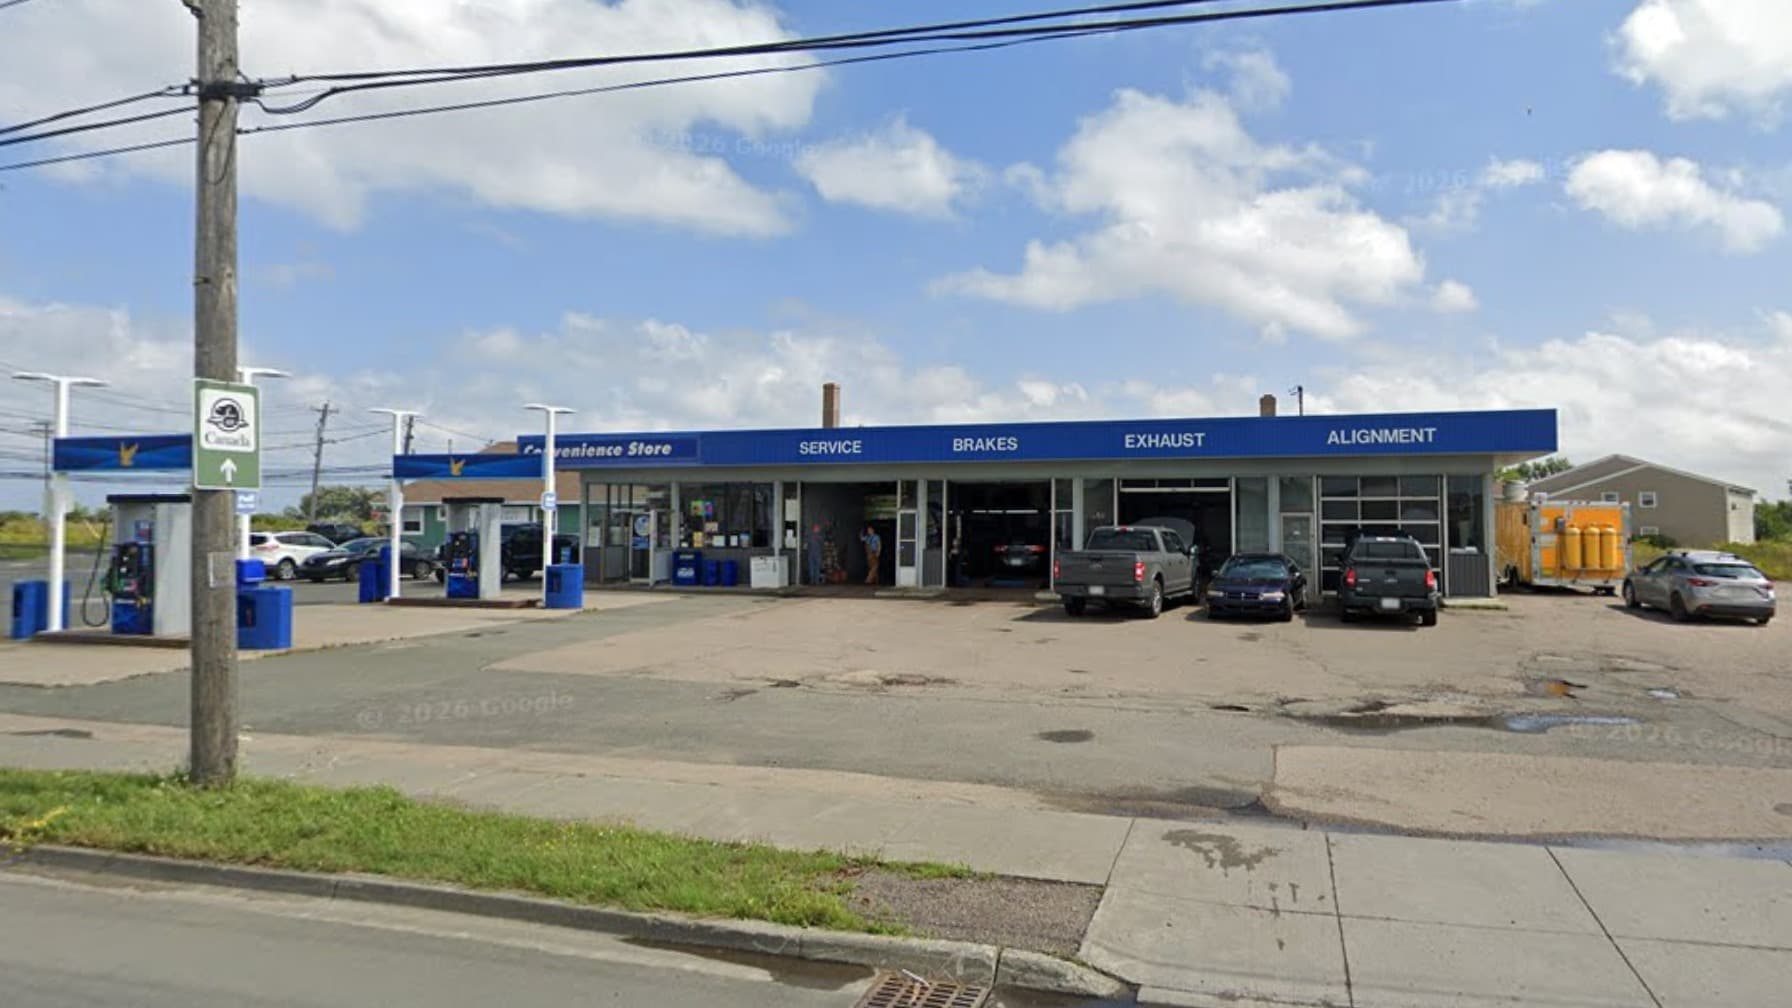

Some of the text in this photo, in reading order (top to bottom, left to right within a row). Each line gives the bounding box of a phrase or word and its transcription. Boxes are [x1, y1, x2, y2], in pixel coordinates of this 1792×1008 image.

[205, 431, 250, 447] Canada
[952, 436, 1019, 452] BRAKES
[1125, 432, 1206, 449] EXHAUST
[1327, 427, 1437, 445] ALIGNMENT
[628, 441, 672, 456] Store
[799, 439, 862, 455] SERVICE
